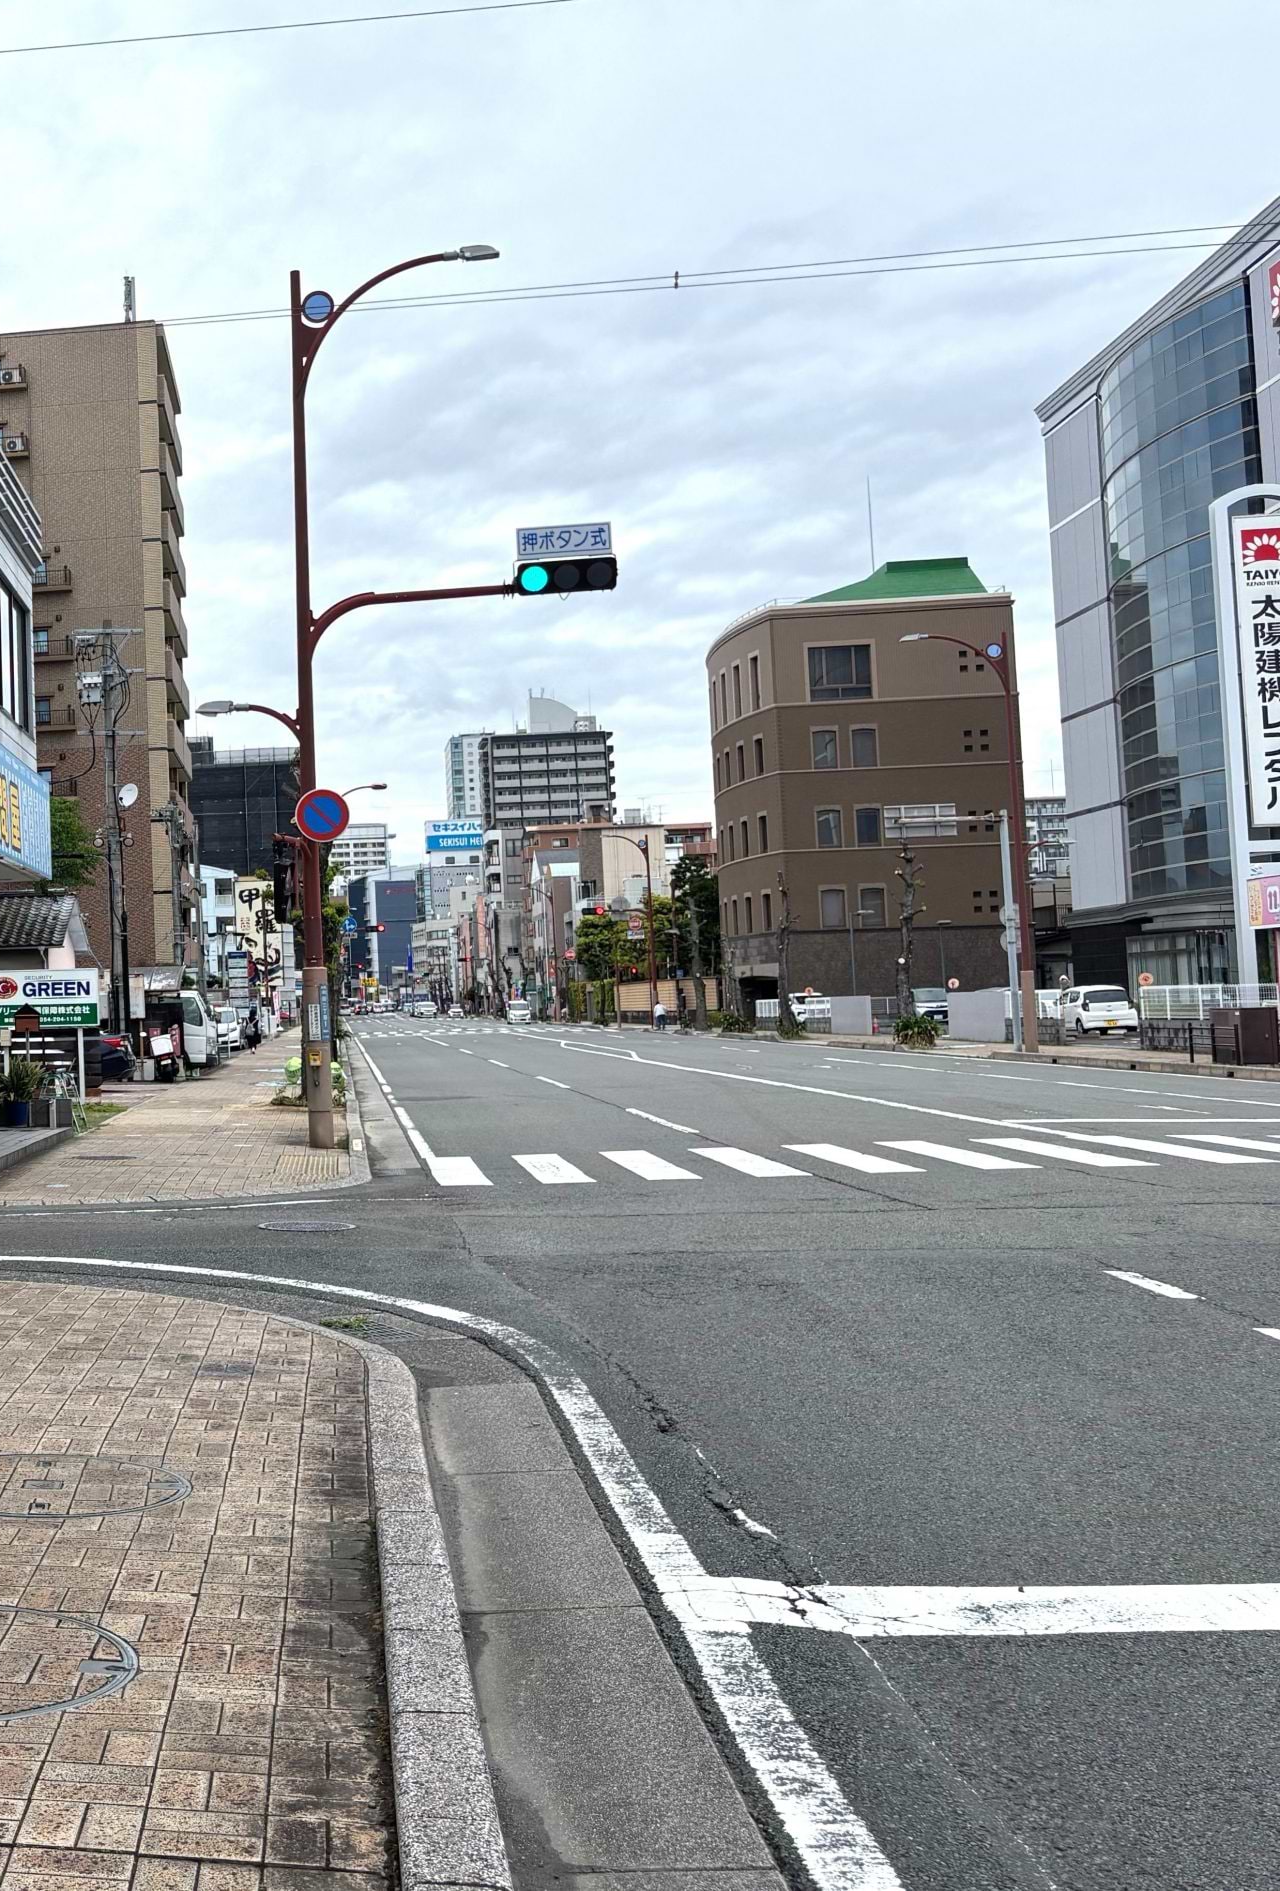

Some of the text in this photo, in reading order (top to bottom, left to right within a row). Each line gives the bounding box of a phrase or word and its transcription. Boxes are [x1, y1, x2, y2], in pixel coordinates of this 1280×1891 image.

[522, 528, 606, 551] 押ボタン式
[1243, 569, 1280, 580] TAIY
[439, 837, 467, 847] SEKISUI
[22, 981, 90, 997] GREEN
